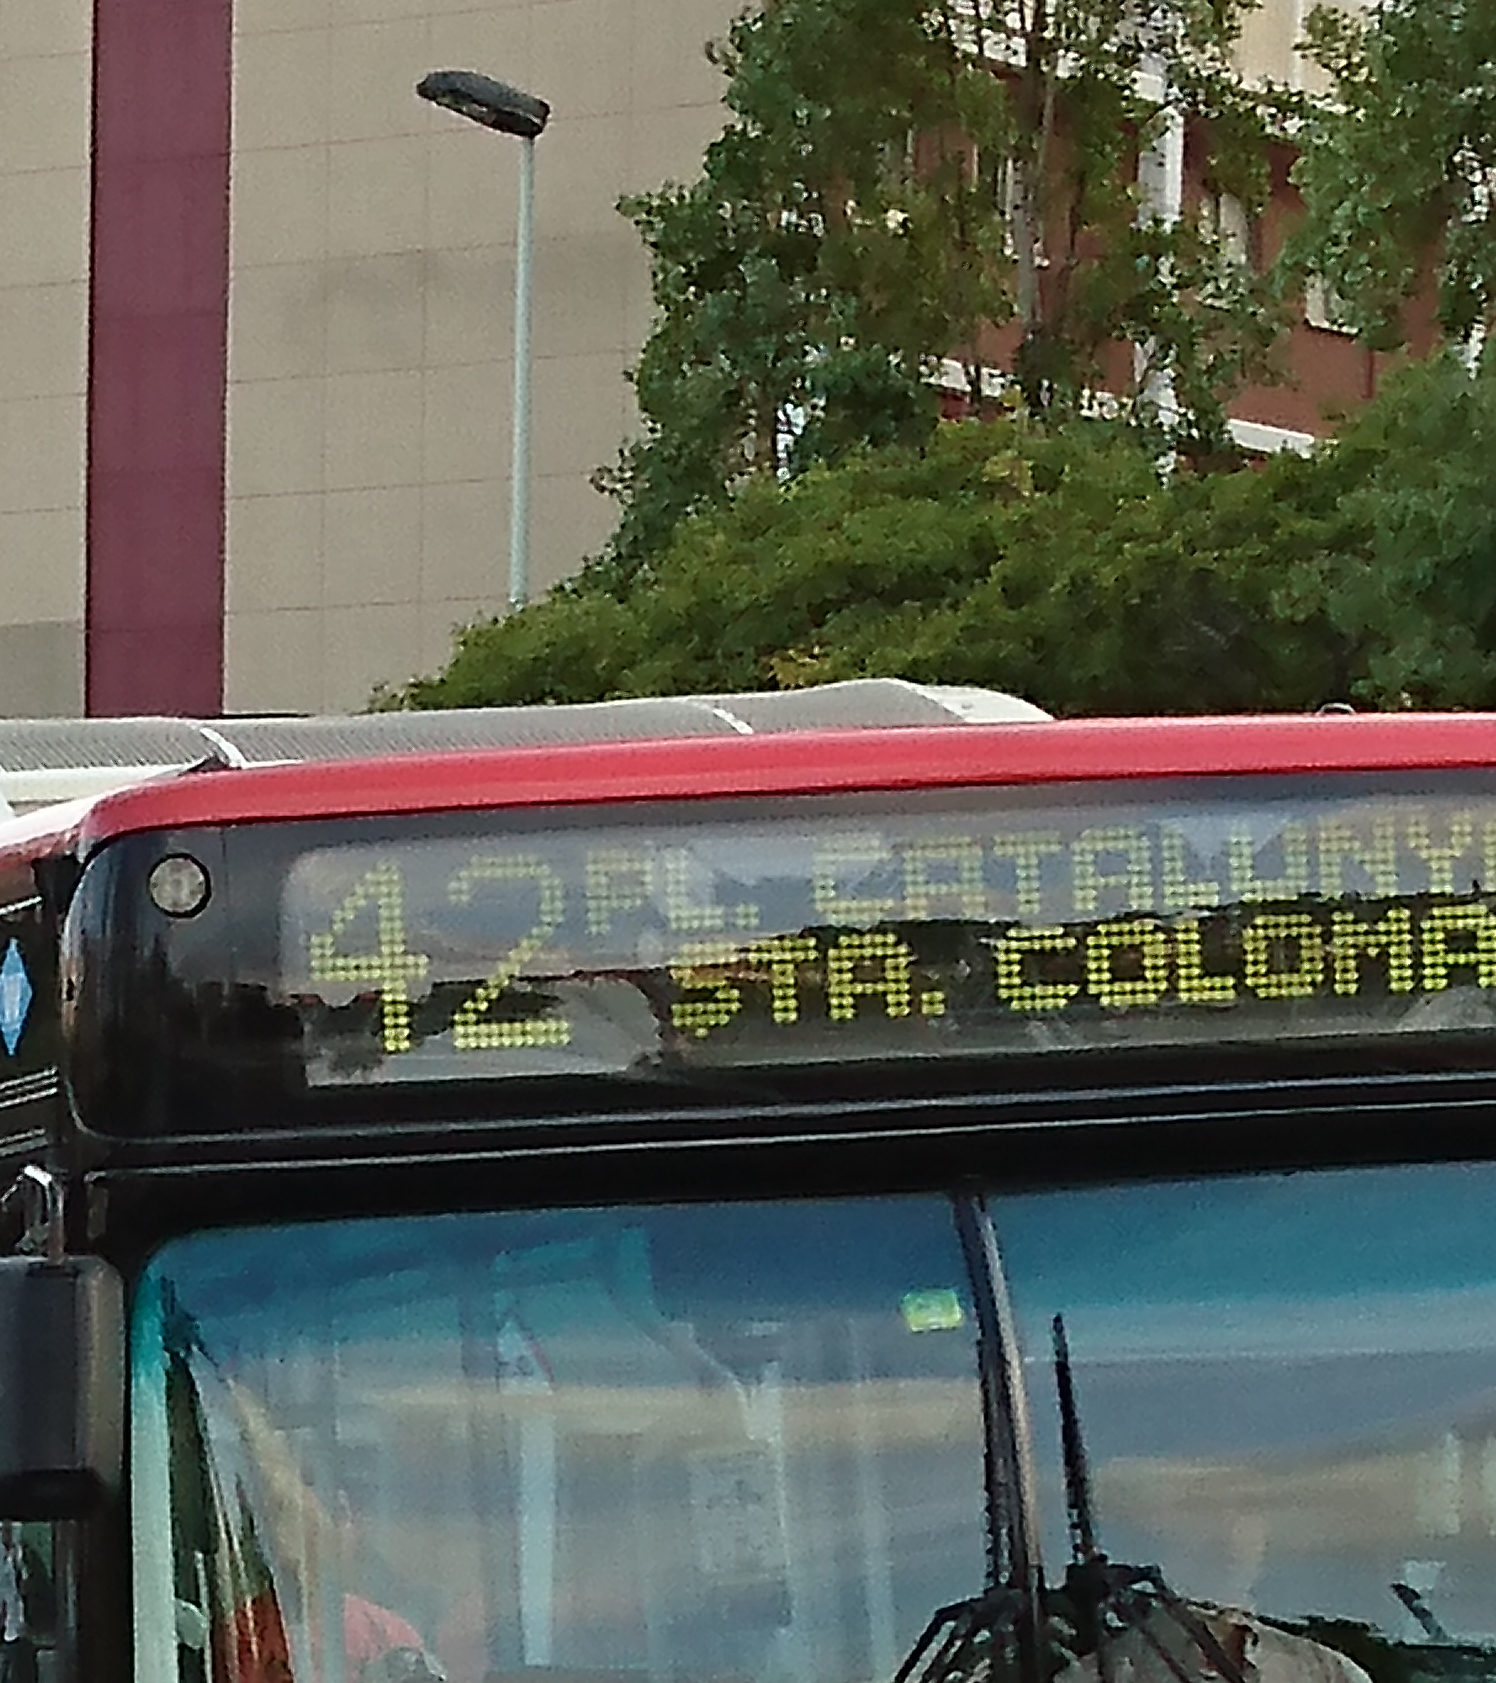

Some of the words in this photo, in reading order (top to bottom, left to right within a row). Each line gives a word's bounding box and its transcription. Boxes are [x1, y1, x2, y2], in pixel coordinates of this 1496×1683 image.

[585, 847, 760, 935] PL.
[309, 855, 574, 1053] 42
[669, 932, 946, 1038] STA.
